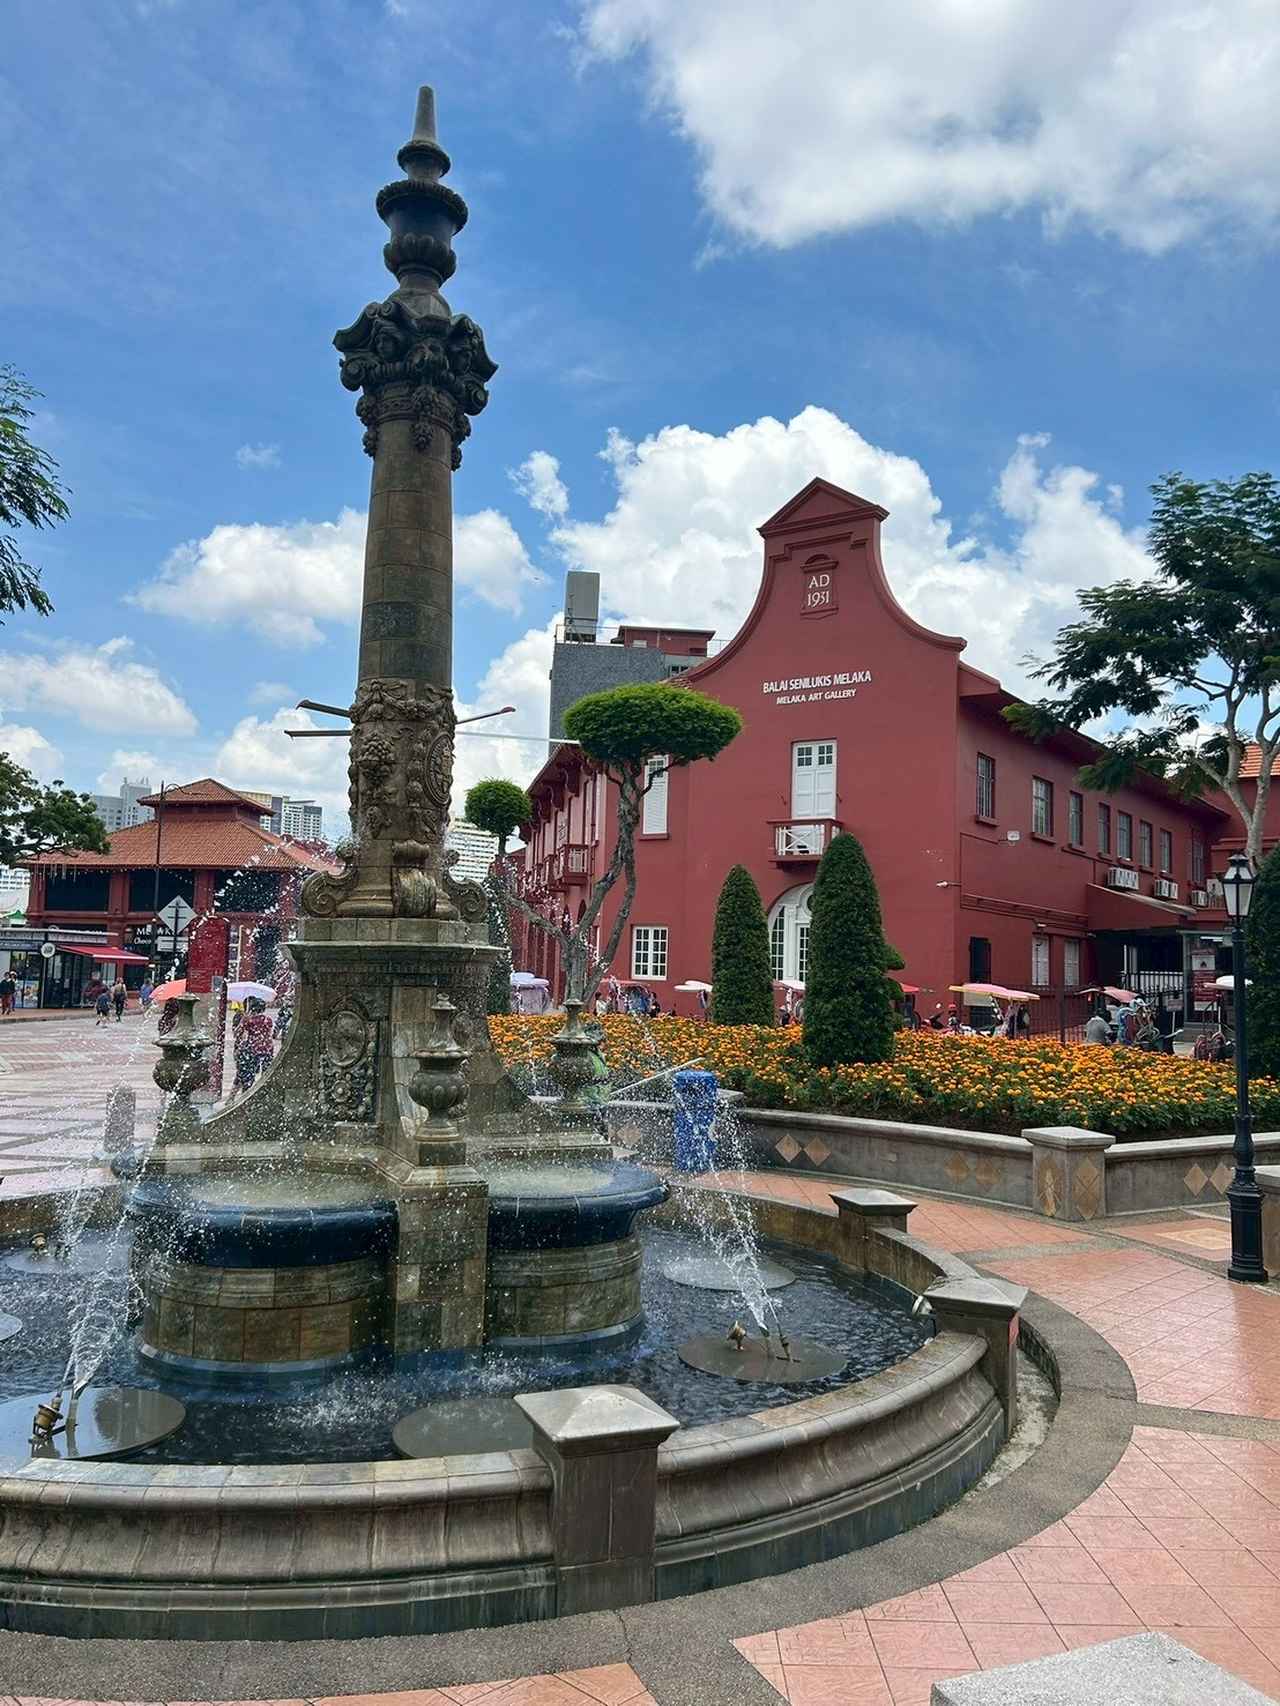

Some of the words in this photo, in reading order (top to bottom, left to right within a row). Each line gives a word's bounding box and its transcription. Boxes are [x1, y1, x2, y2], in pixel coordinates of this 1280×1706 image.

[809, 574, 830, 588] AD
[807, 591, 830, 607] 1931
[763, 680, 788, 693] BALAI
[833, 671, 871, 685] MELAKA
[776, 694, 806, 704] MELAKA
[808, 692, 823, 701] ART
[824, 688, 856, 699] GALLERY
